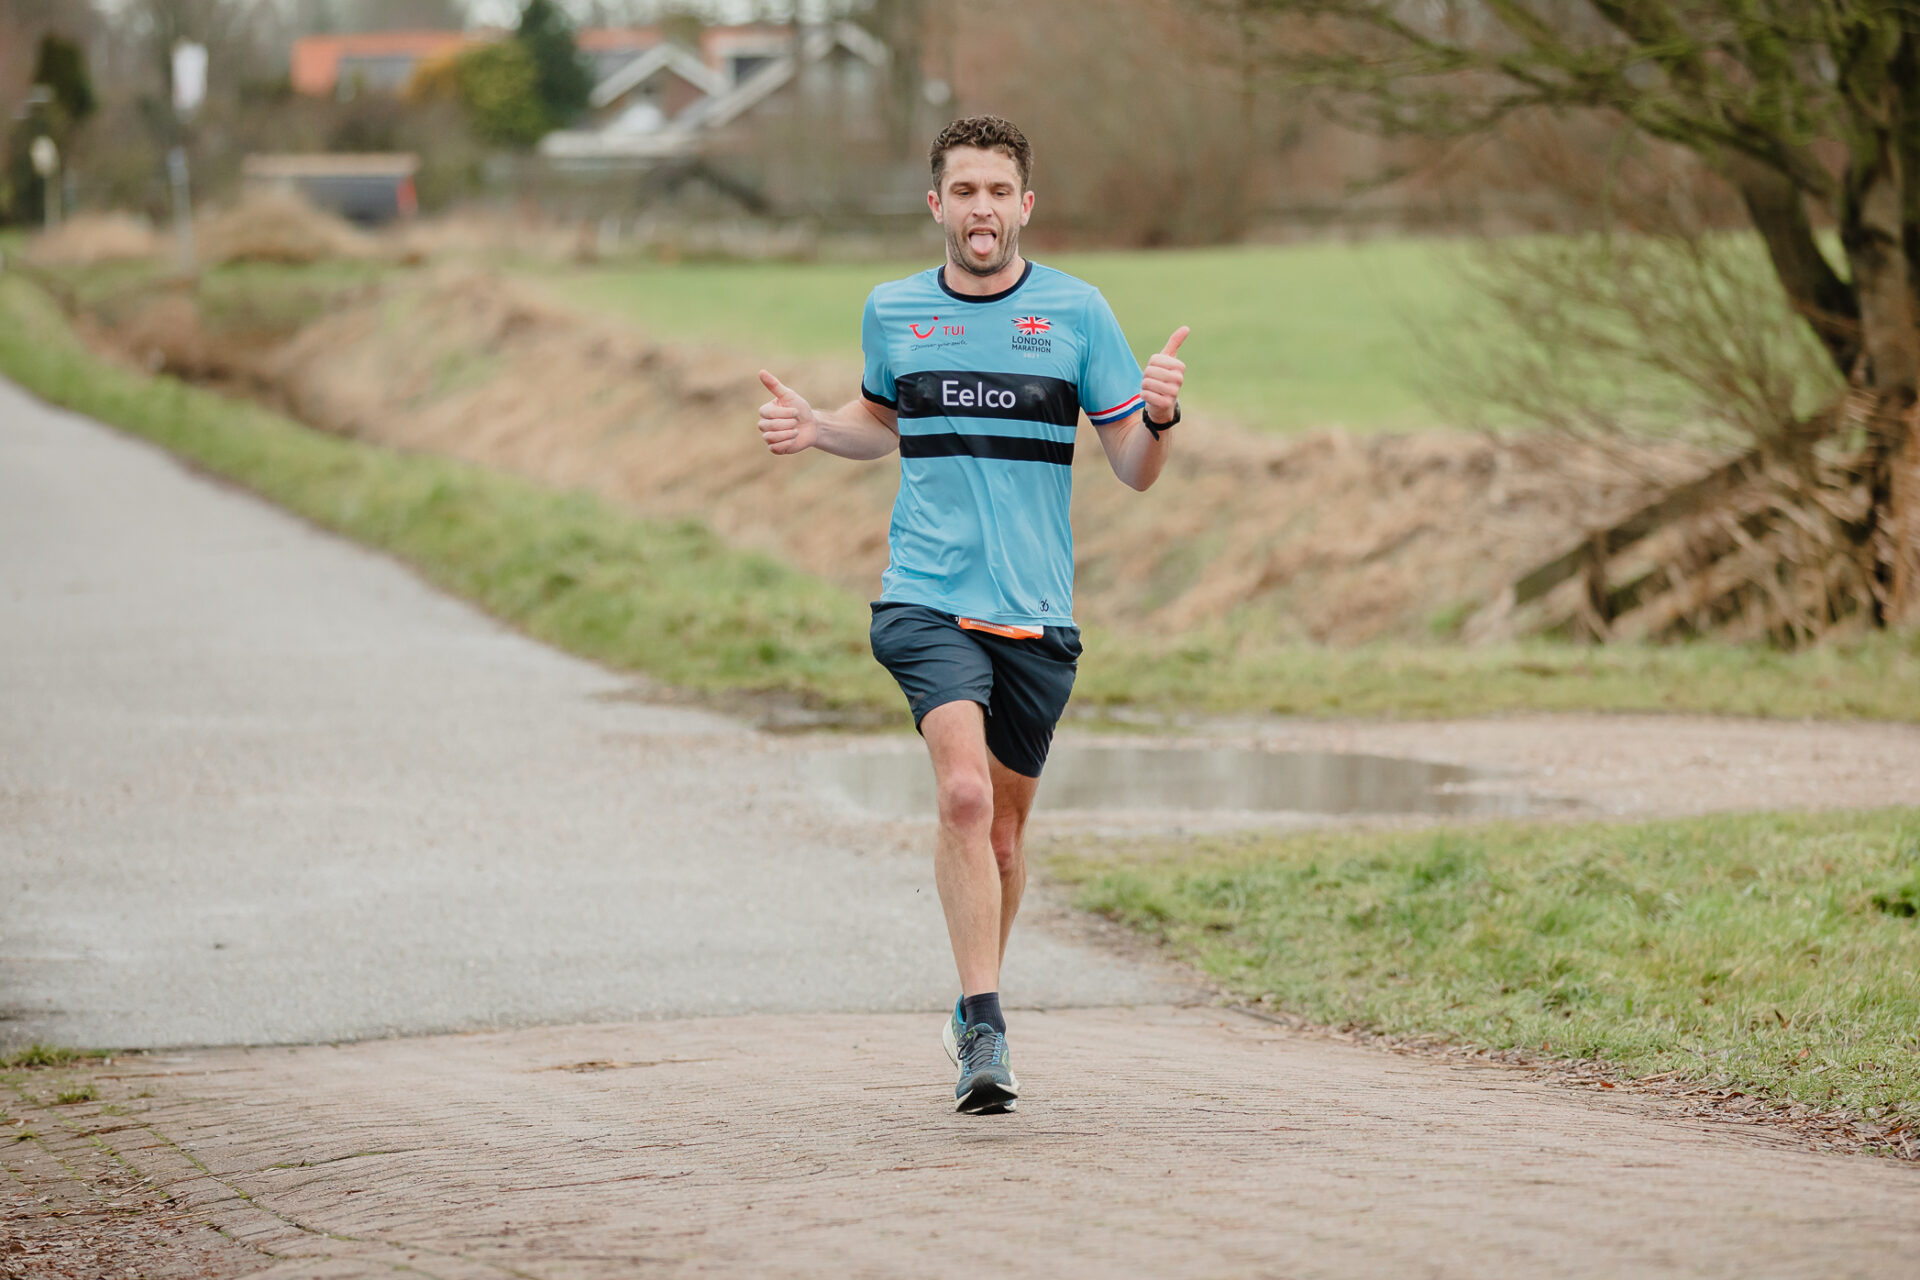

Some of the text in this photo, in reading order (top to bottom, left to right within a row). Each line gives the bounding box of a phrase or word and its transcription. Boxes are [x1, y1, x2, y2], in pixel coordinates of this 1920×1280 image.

[942, 325, 965, 336] TUI
[1011, 335, 1051, 347] LONDON
[1011, 343, 1051, 353] MARATHON
[942, 380, 1016, 408] Eelco
